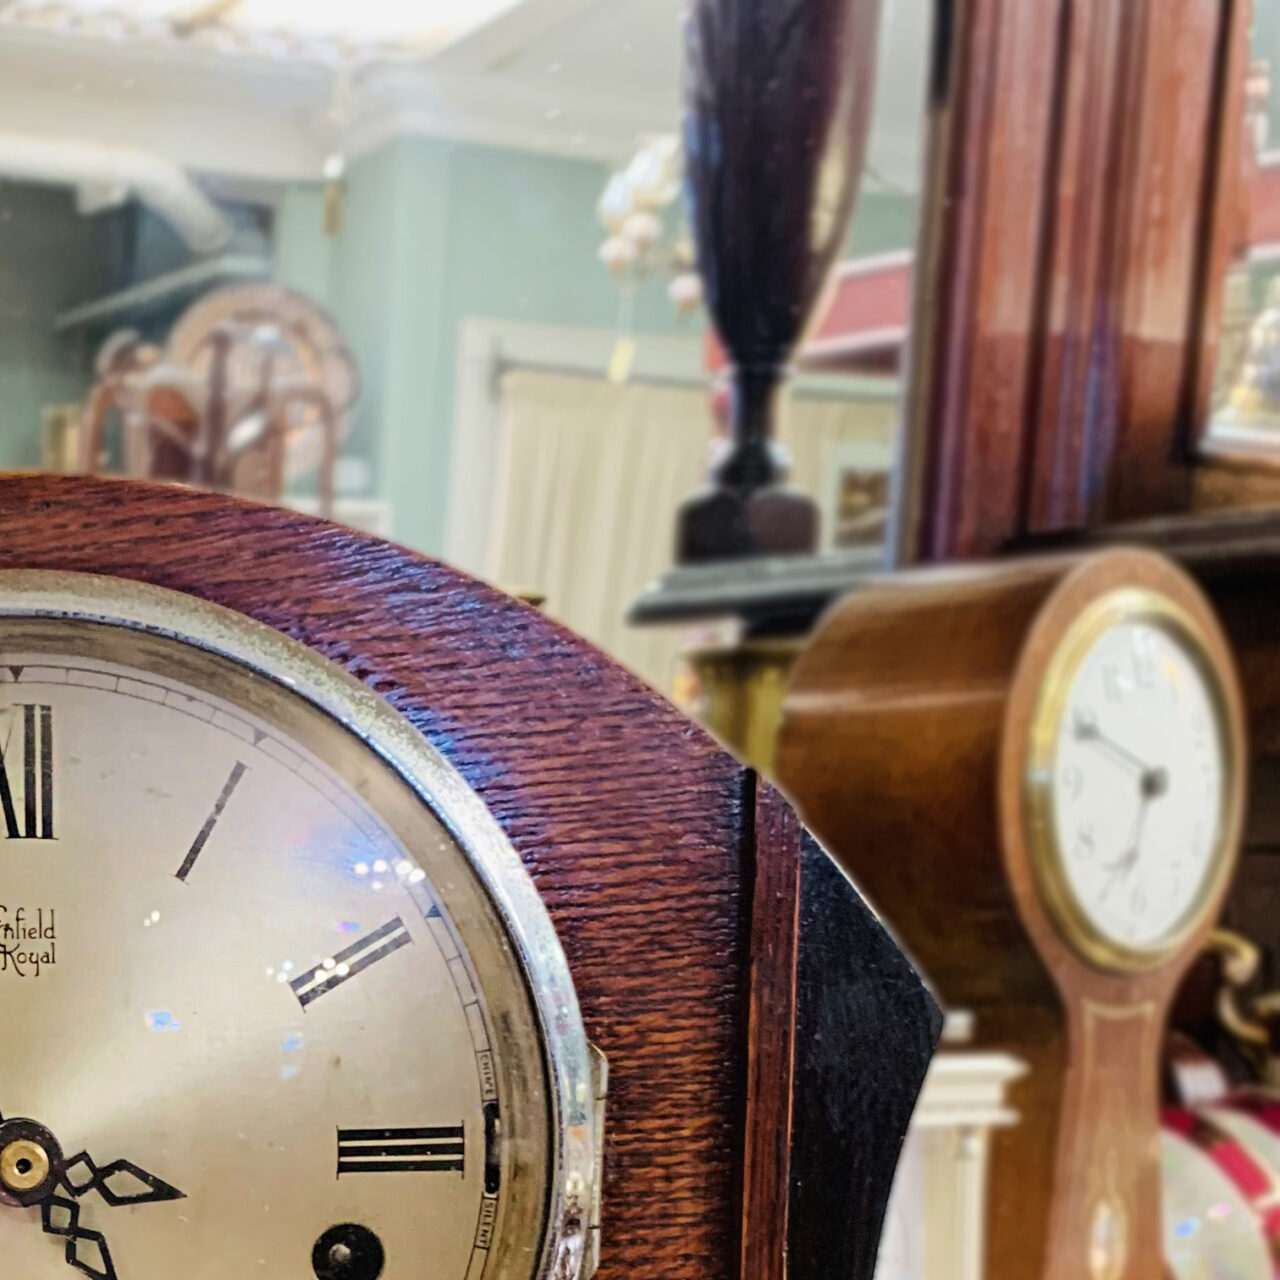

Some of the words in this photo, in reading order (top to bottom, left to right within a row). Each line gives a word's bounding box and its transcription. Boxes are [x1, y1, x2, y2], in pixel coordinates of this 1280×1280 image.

[173, 760, 251, 884] I
[288, 915, 415, 1014] II
[336, 1119, 465, 1180] III
[479, 1201, 495, 1247] SILENT
